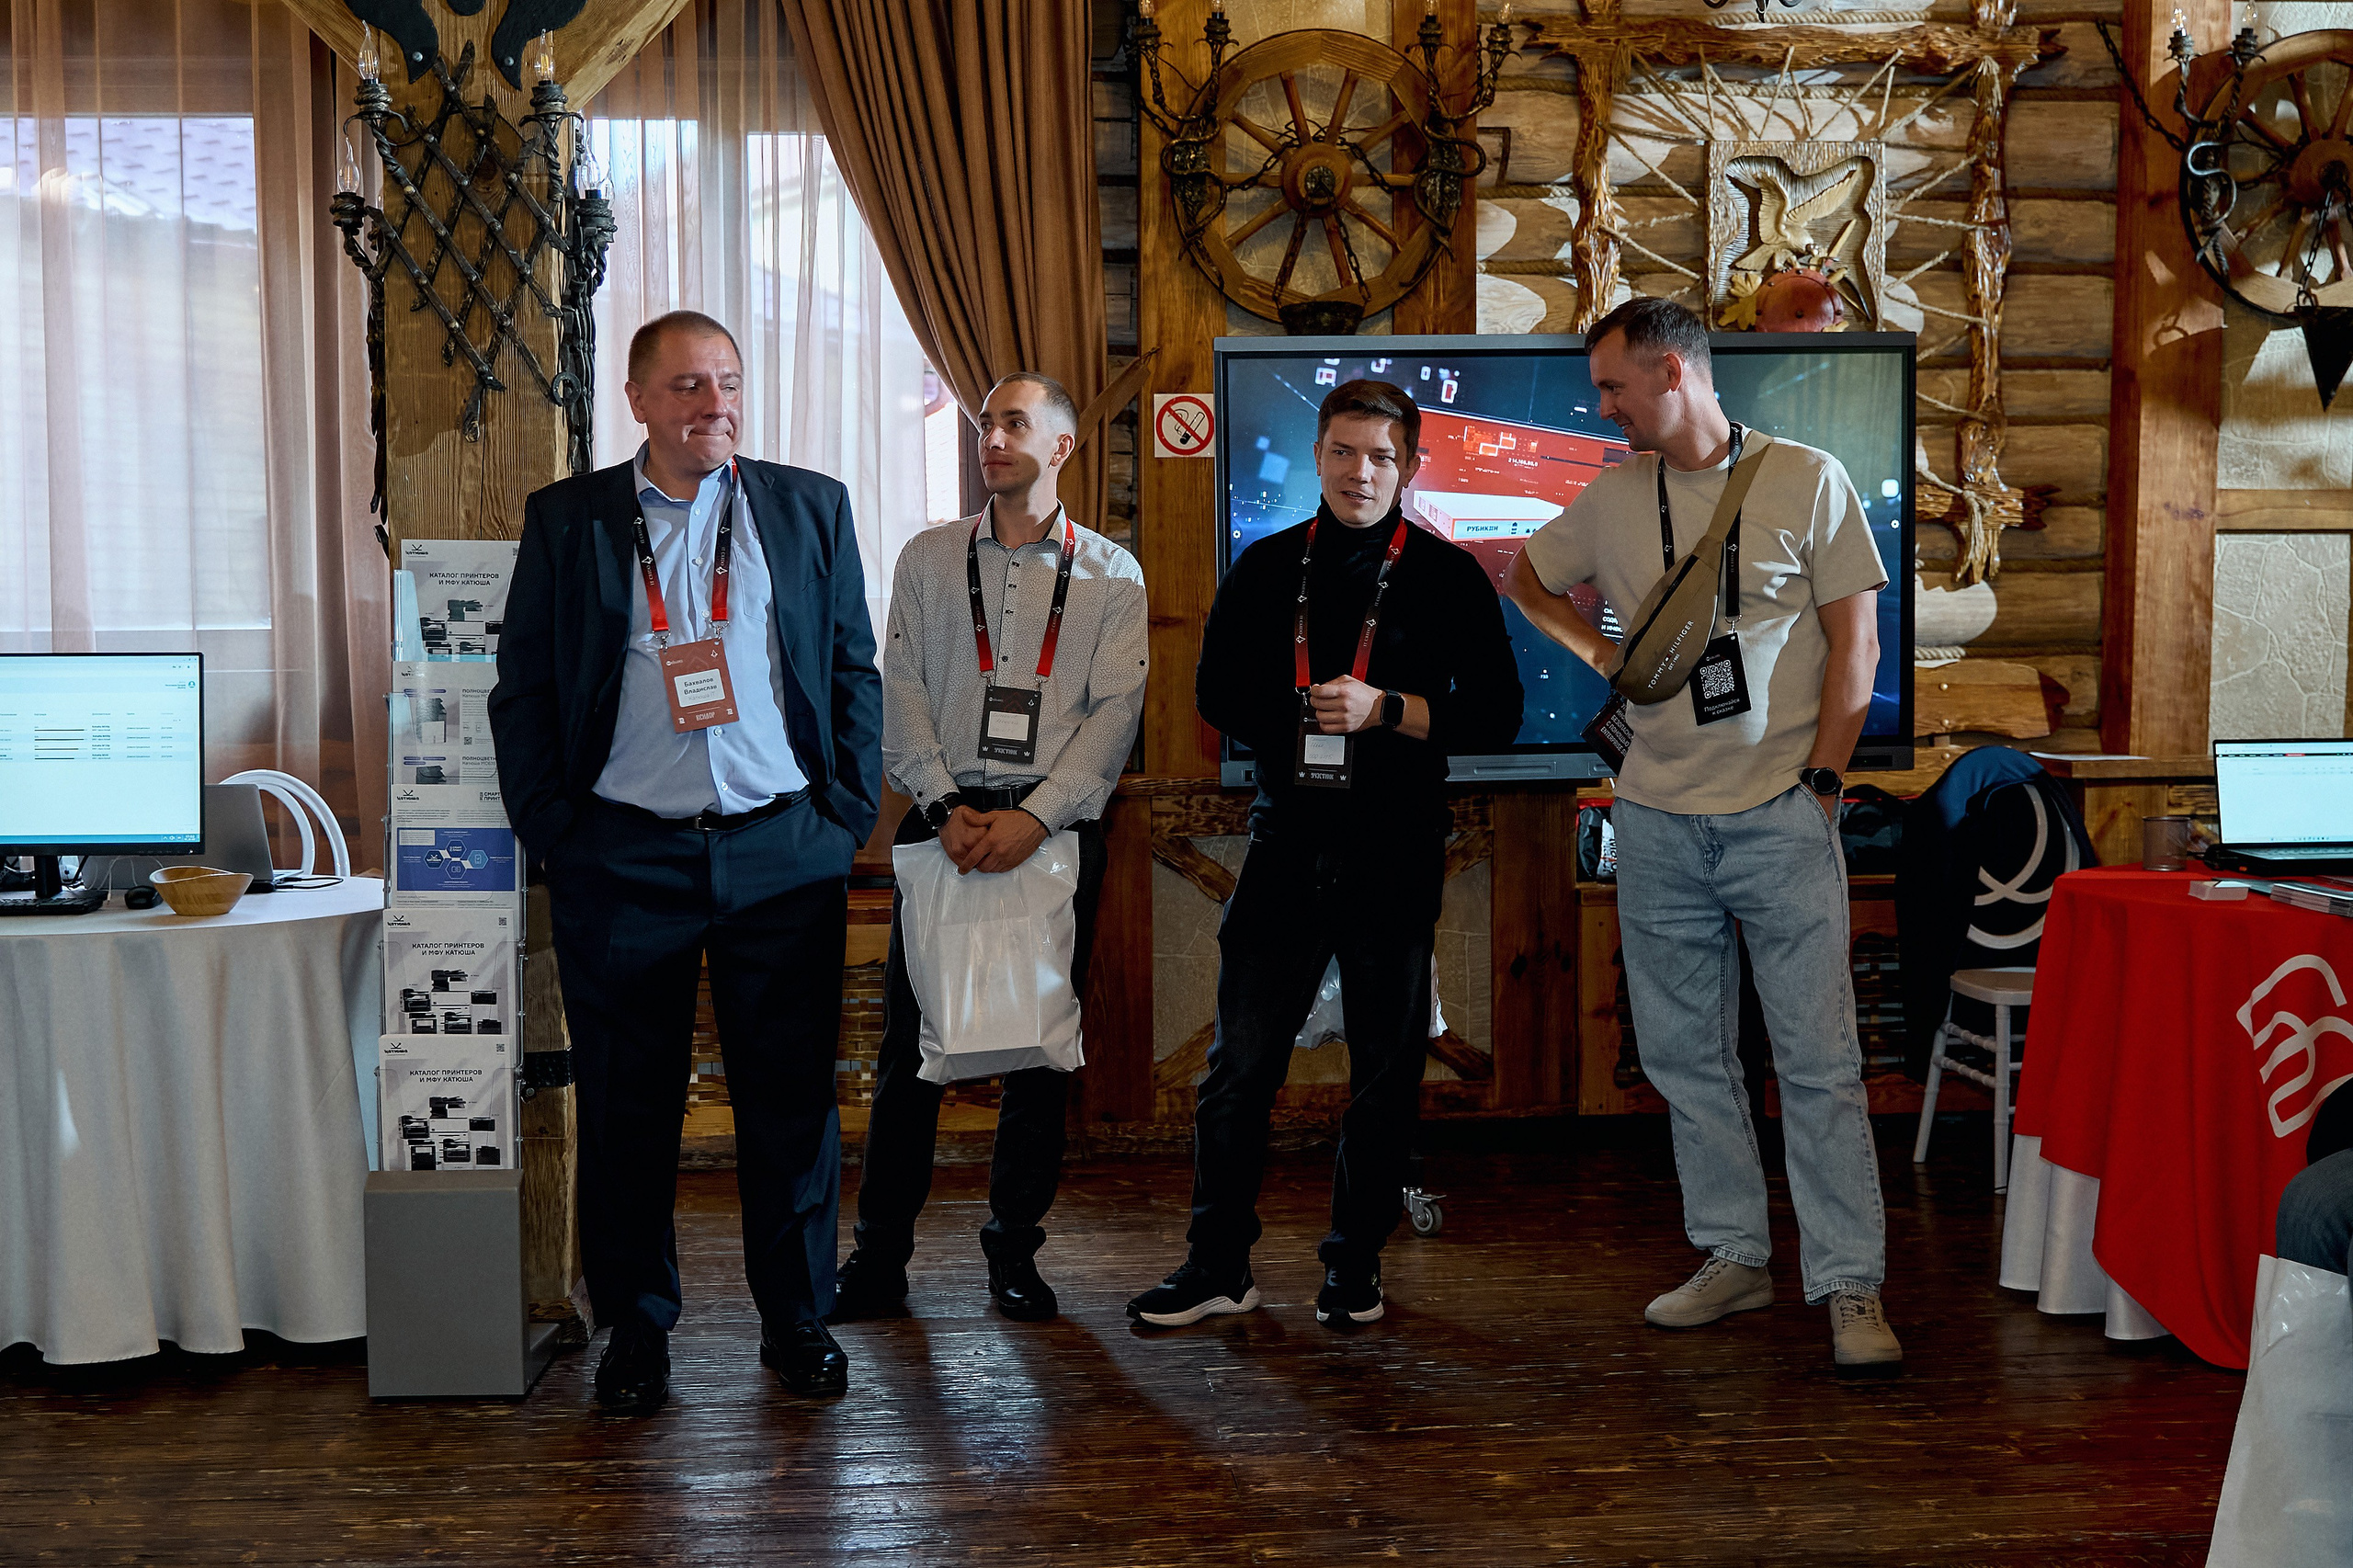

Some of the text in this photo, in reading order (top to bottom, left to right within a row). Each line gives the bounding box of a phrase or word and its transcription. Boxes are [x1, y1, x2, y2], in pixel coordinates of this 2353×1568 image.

[1647, 620, 1694, 689] TOMMY HILFIGER
[684, 677, 714, 687] Бахвалов
[684, 685, 717, 696] Владислав
[1600, 726, 1623, 751] ENTERPRISE
